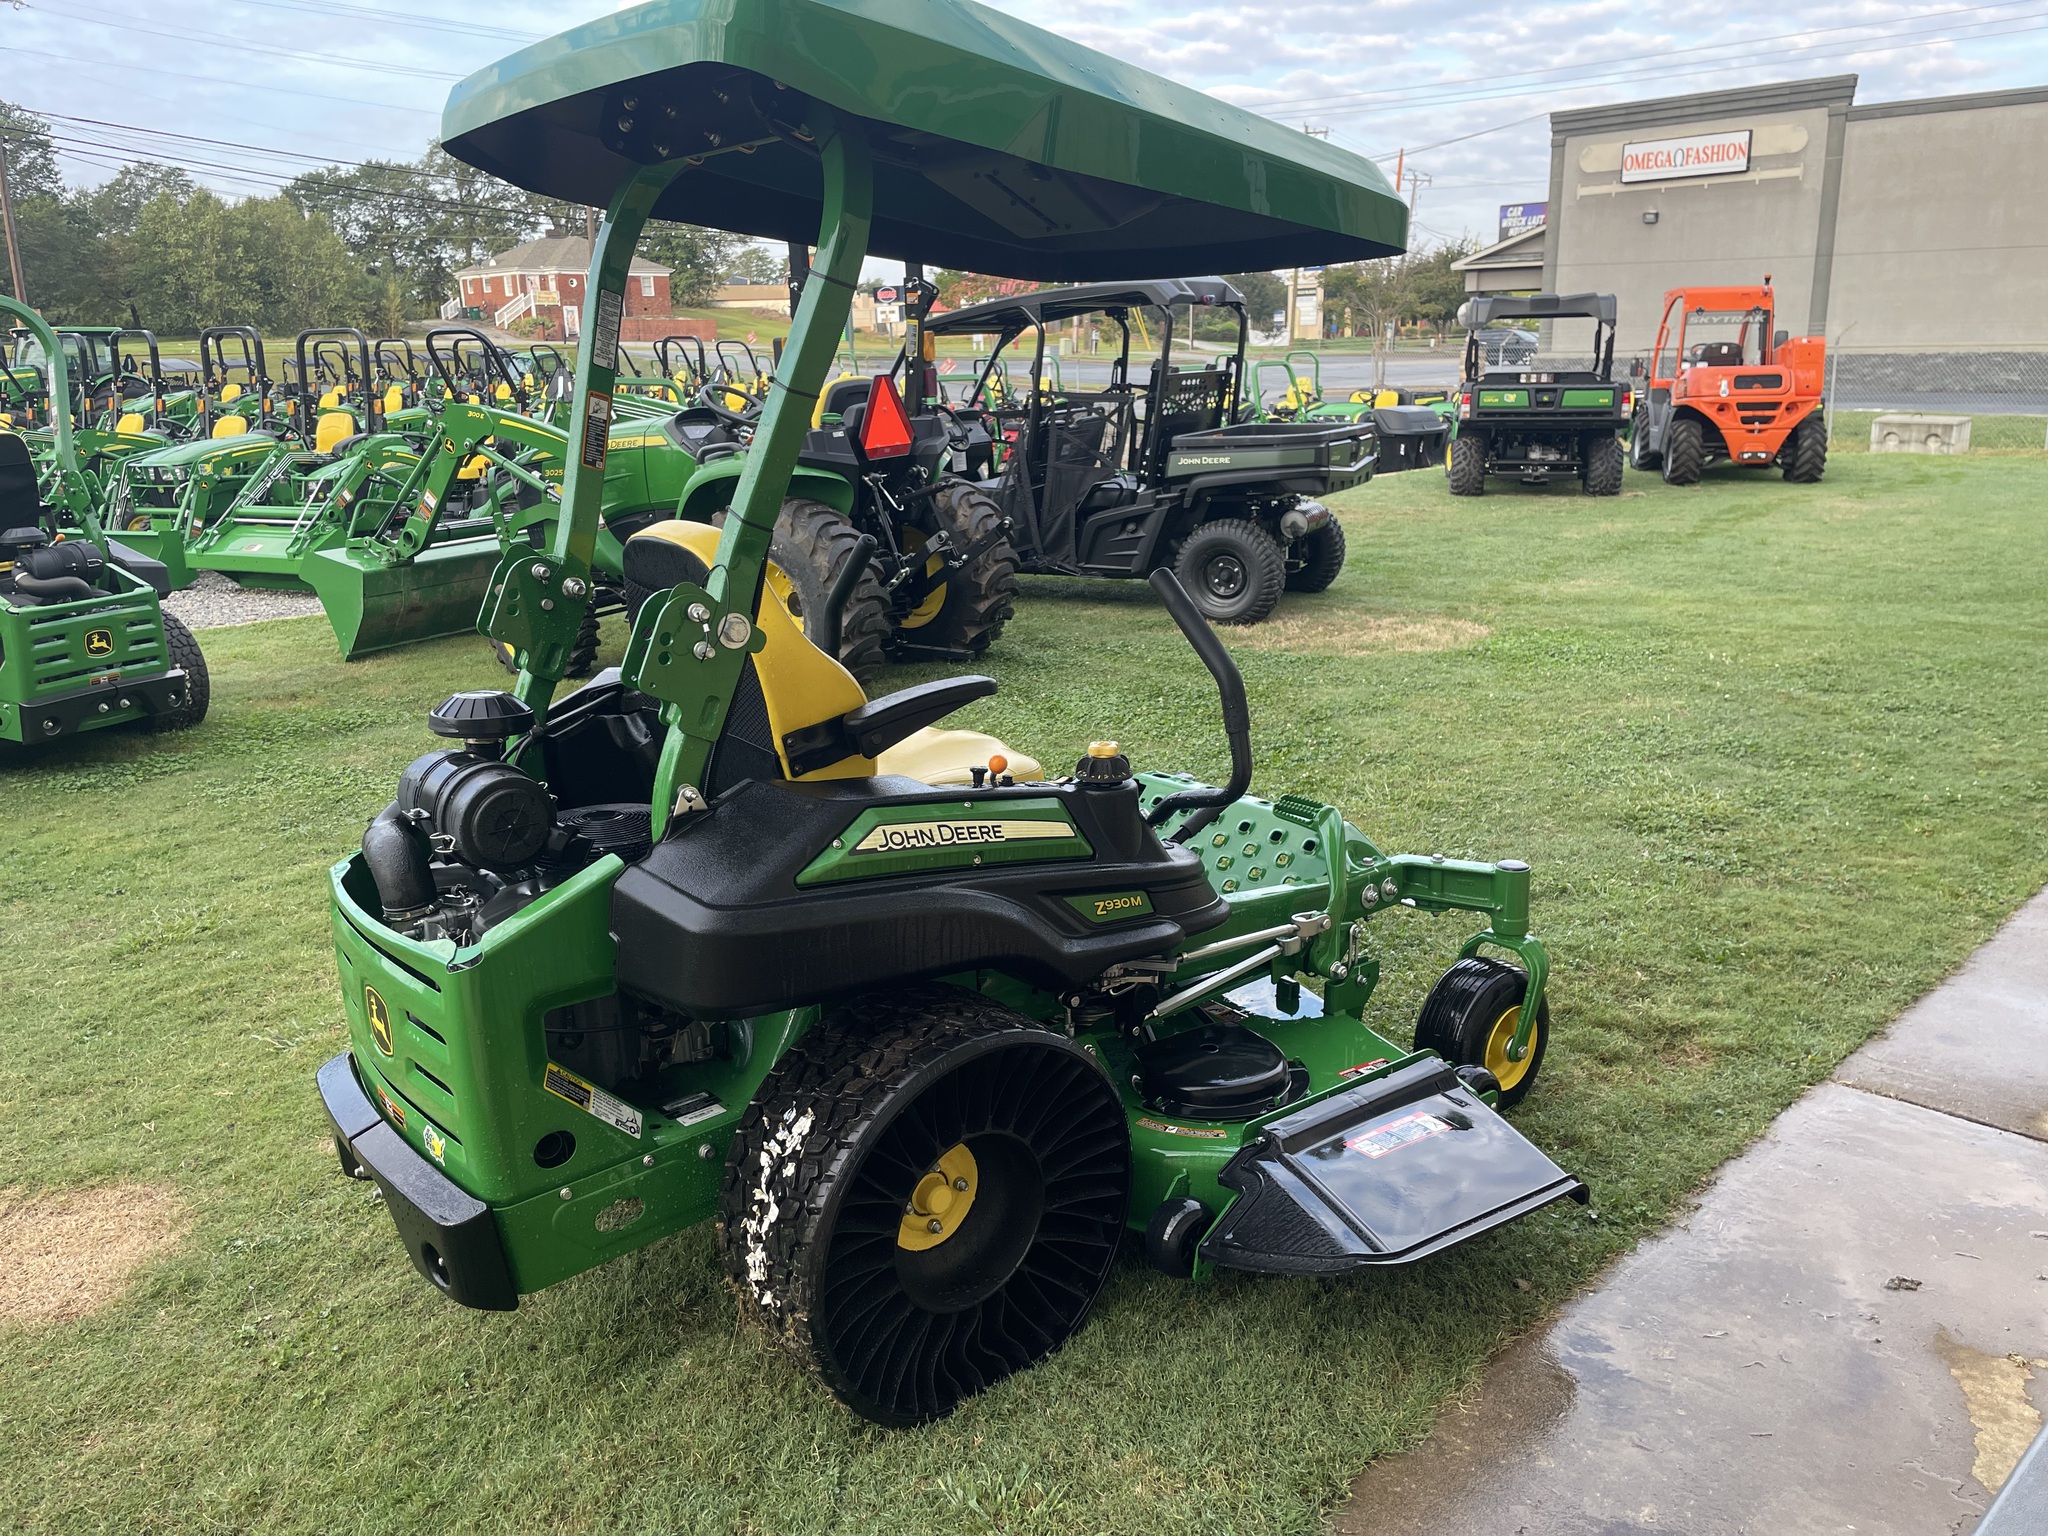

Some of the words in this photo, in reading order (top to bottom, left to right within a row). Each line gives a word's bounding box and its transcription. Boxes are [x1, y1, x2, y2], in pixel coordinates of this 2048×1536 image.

[1623, 150, 1672, 172] OMEGA
[1685, 141, 1748, 166] FASHION
[1506, 206, 1524, 217] CAR
[1689, 314, 1767, 324] SKYTRAK
[610, 440, 638, 449] DEERE
[1178, 457, 1200, 465] JOHN
[1202, 456, 1231, 464] DEERE
[878, 828, 935, 848] JOHN
[936, 824, 1005, 843] DEERE
